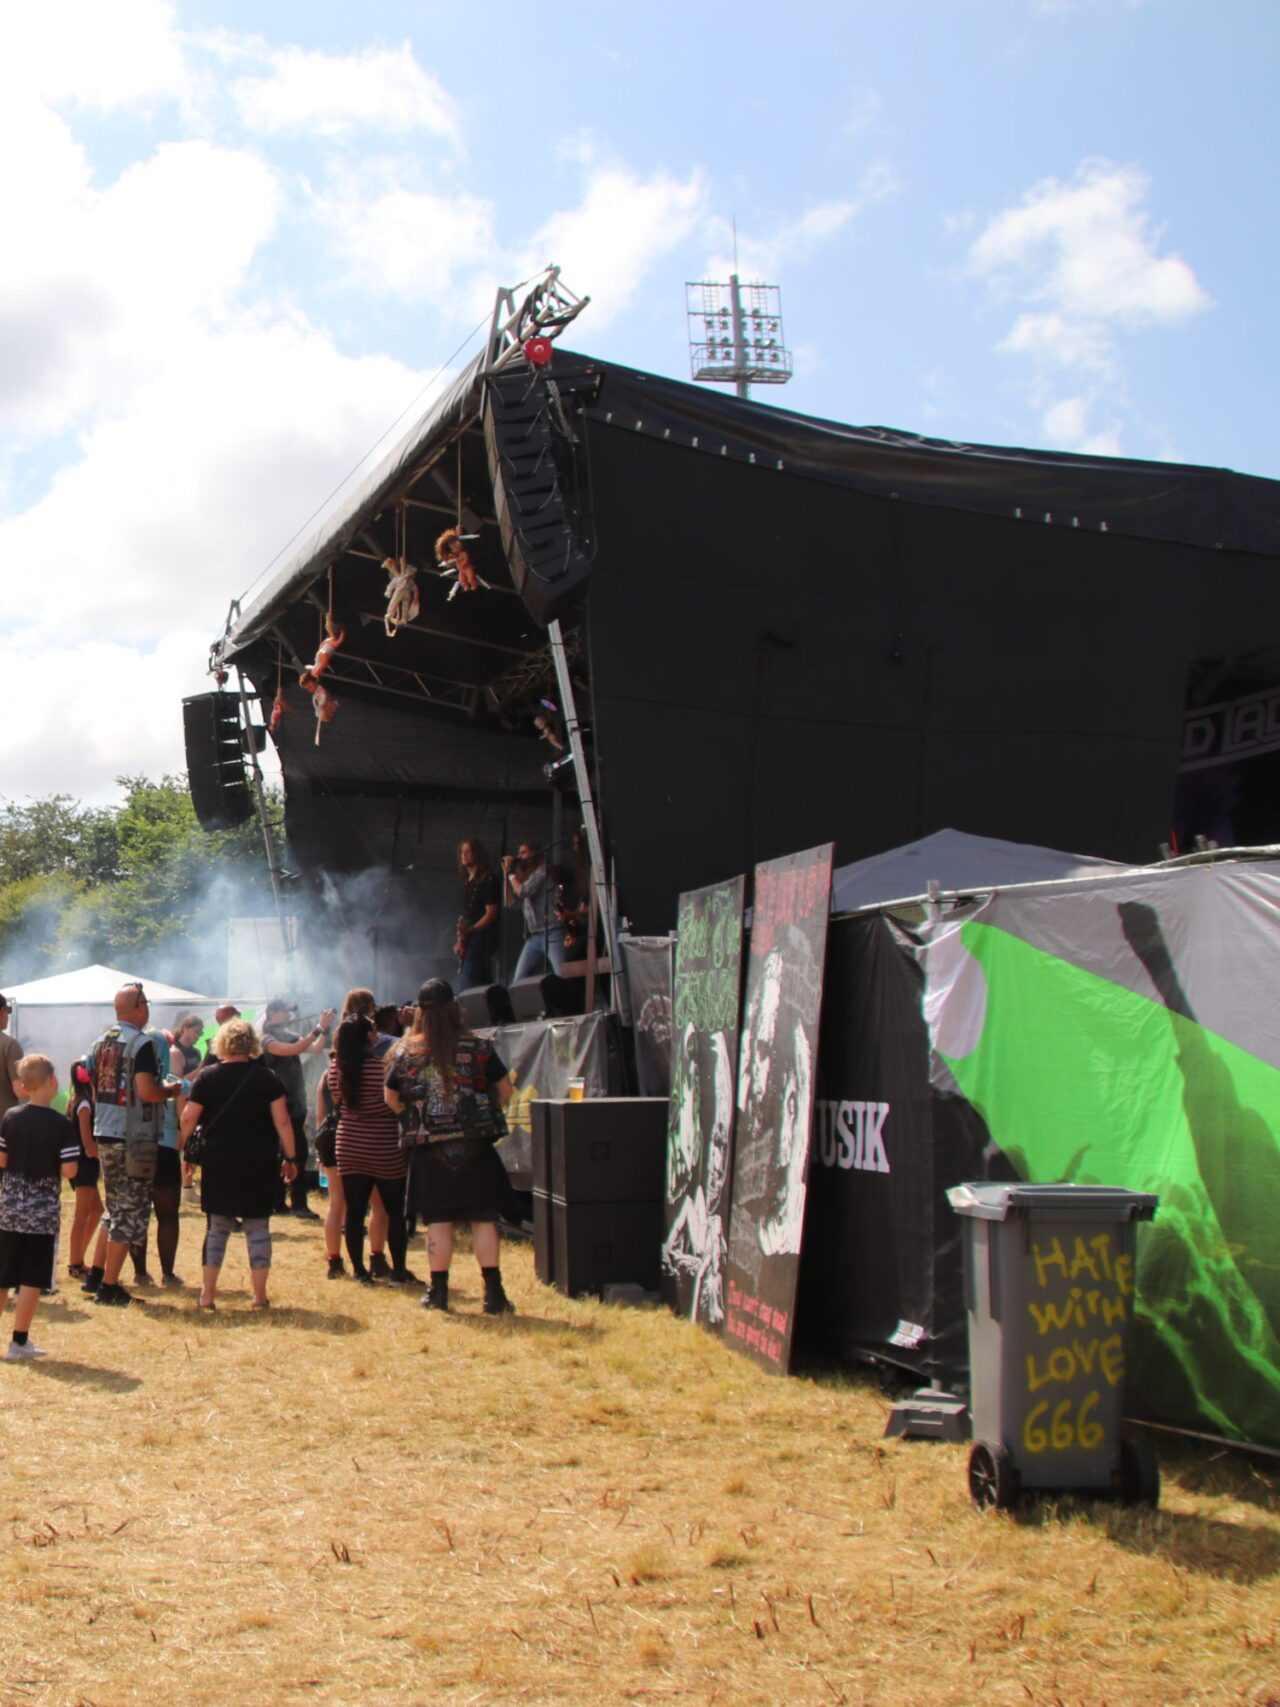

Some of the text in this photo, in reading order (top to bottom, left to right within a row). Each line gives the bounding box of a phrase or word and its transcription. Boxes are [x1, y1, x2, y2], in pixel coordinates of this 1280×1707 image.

[816, 1100, 890, 1173] USIK
[1032, 1234, 1134, 1294] HATE
[1027, 1336, 1126, 1392] LOVE
[1023, 1391, 1105, 1453] 666
